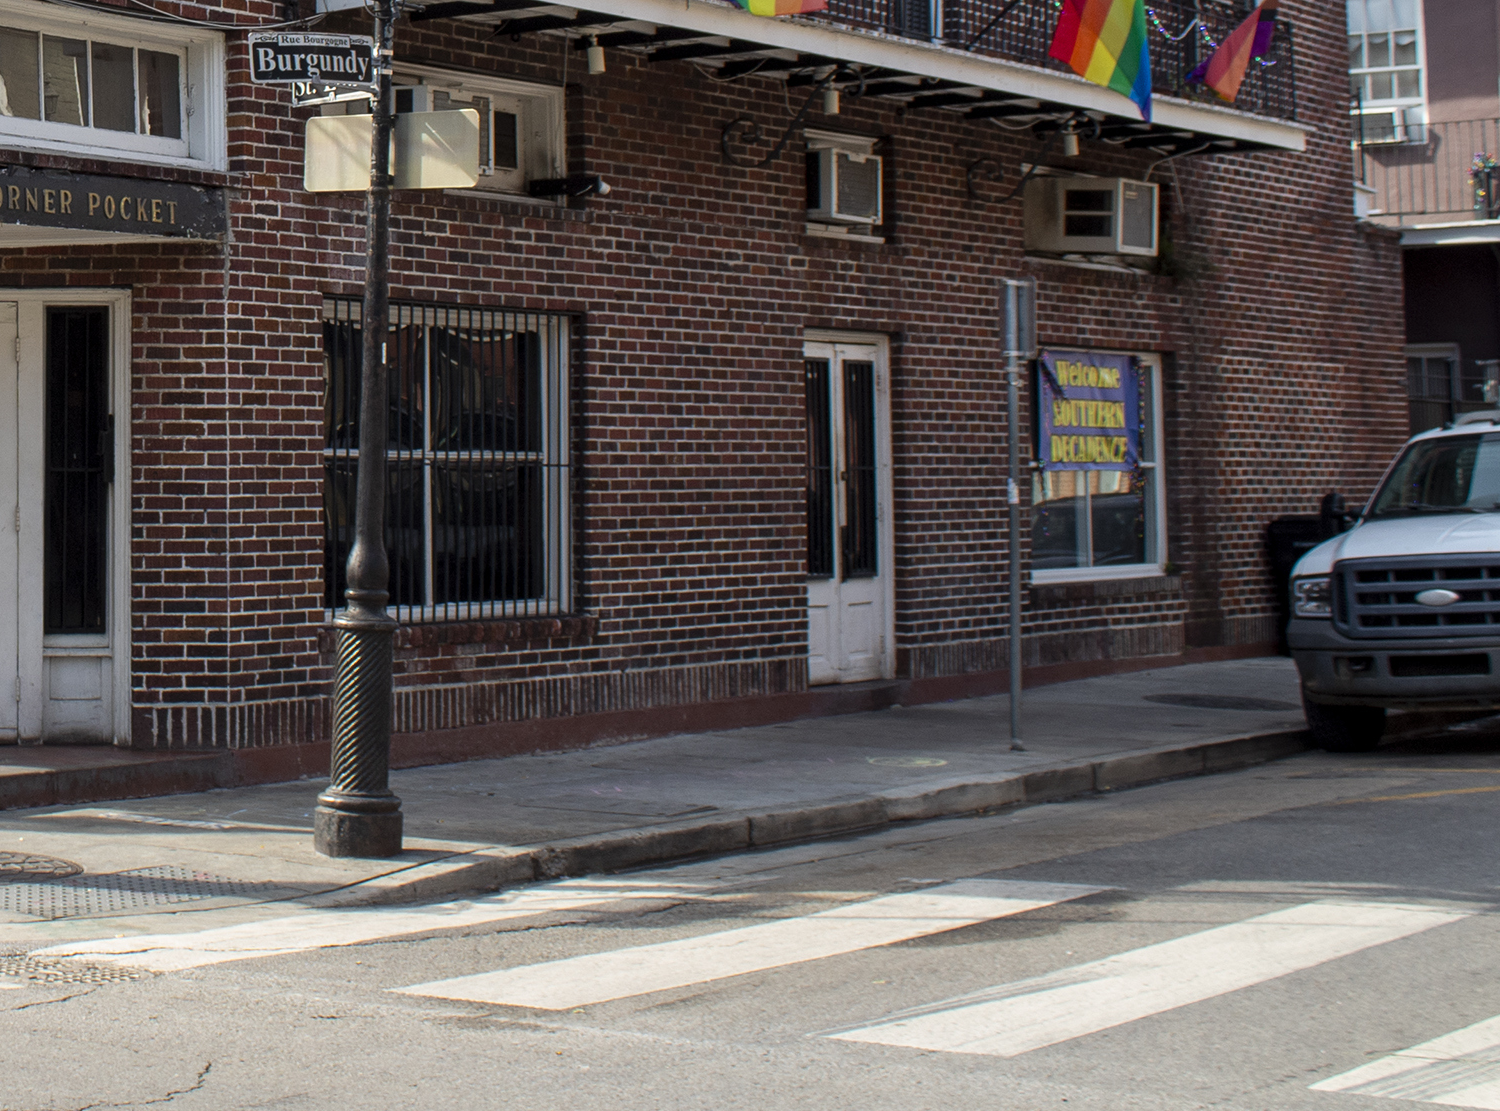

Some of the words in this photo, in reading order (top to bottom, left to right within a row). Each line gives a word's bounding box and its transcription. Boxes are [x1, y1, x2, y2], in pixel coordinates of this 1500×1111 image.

[280, 35, 301, 45] Rue
[303, 35, 349, 46] Bourgogne
[256, 47, 370, 81] Burgundy
[88, 192, 178, 225] POCKET
[1055, 360, 1121, 388] Welcome
[1053, 399, 1125, 428] SOUTHERN
[1051, 435, 1128, 463] DECADENCE
